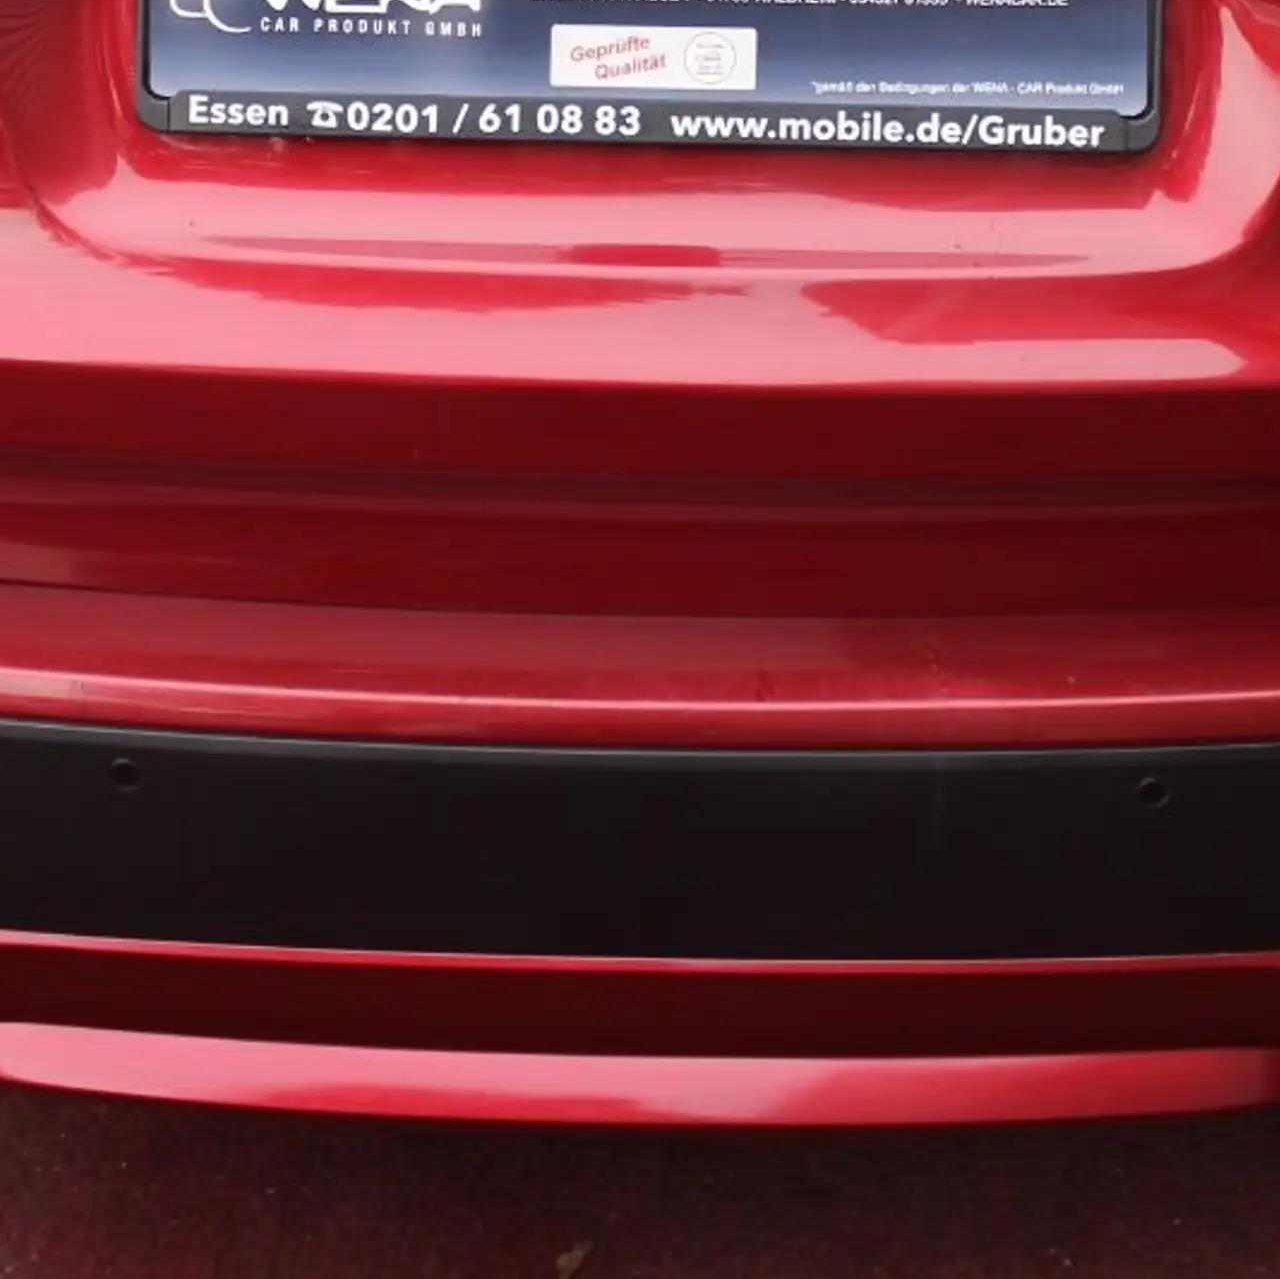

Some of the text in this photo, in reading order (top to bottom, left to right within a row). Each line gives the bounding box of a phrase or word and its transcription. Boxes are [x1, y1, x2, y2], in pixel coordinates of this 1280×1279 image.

[260, 16, 482, 38] CAR PRODUKT GMBH
[570, 35, 651, 62] Geprüfte
[594, 53, 668, 81] Qualität
[188, 94, 290, 127] Essen
[346, 100, 439, 135] 0201
[478, 103, 522, 134] 61
[536, 103, 584, 134] 08
[594, 105, 642, 137] 83
[669, 109, 1106, 147] www.mobile.de/Gruber
